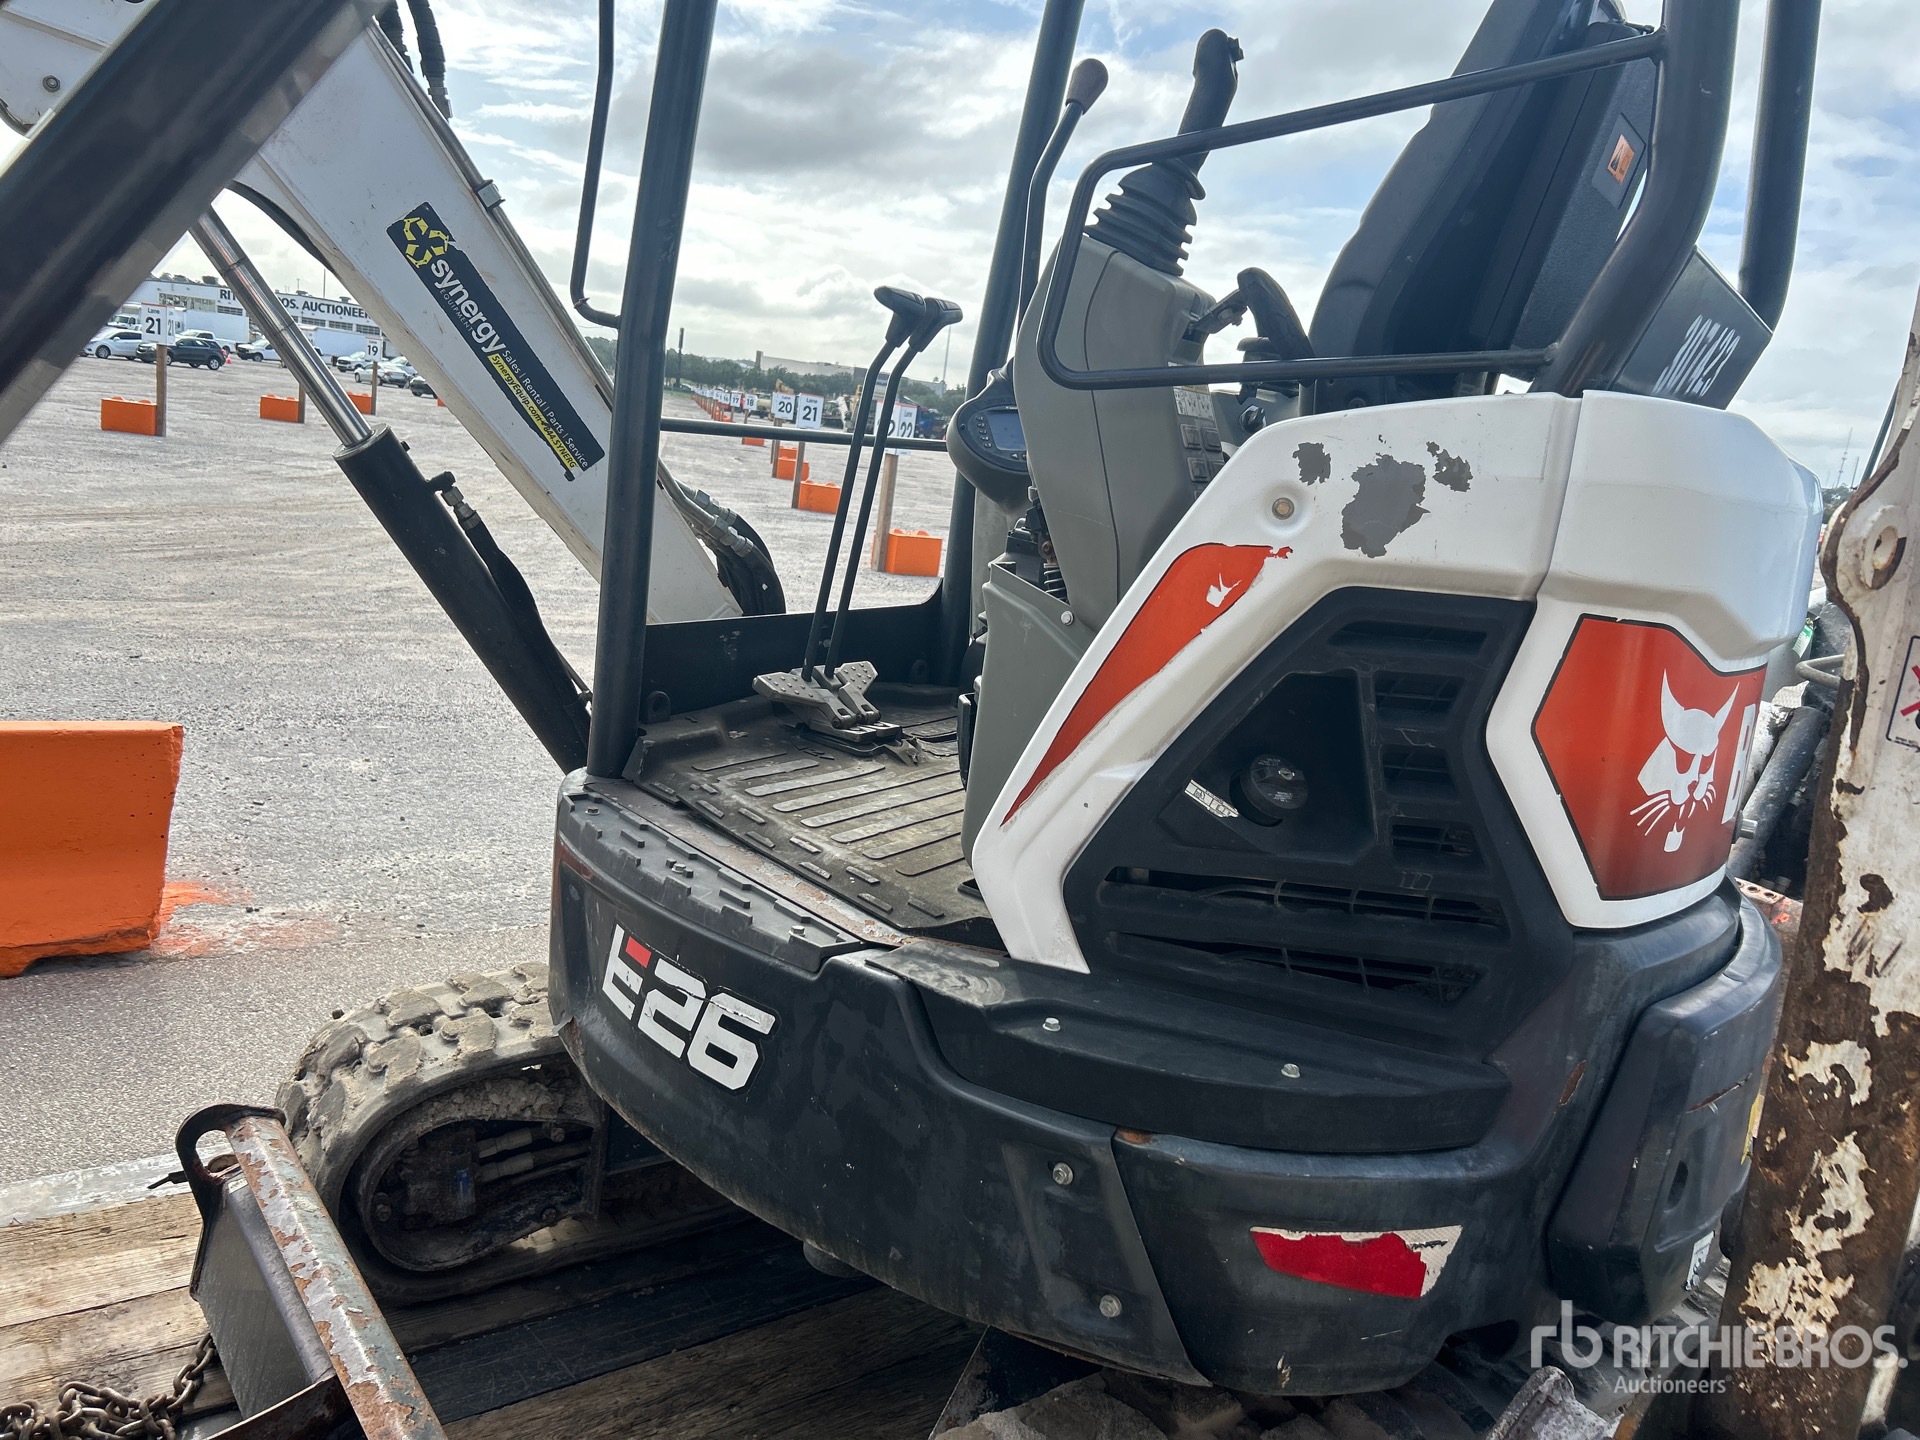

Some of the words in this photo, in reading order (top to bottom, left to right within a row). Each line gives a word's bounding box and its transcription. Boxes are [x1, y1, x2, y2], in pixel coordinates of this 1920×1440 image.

[278, 296, 299, 309] OS.
[430, 259, 506, 353] synergy
[440, 289, 473, 332] EQUIPMENT
[145, 316, 161, 335] 21
[367, 345, 378, 356] 19
[502, 350, 521, 374] Sales
[522, 378, 546, 408] Rental
[546, 411, 564, 434] Parts
[565, 437, 588, 468] Service
[778, 401, 792, 414] 20
[802, 405, 817, 422] 21
[900, 421, 912, 437] 22
[602, 923, 775, 1090] E26
